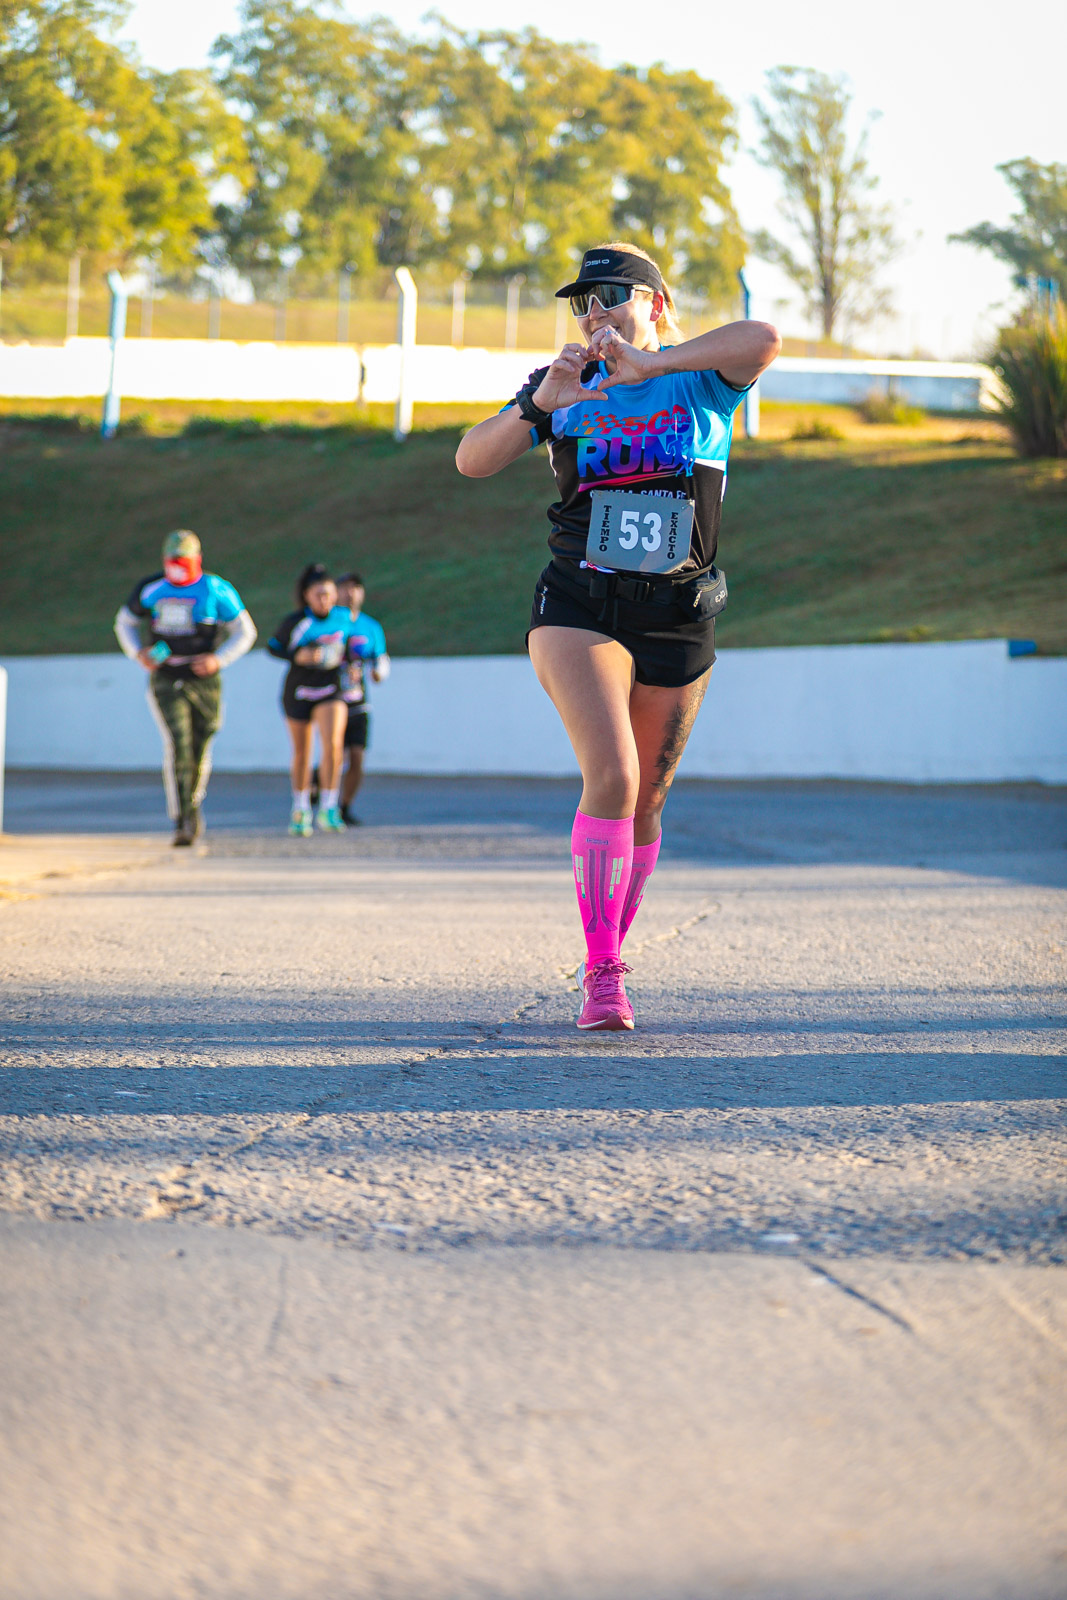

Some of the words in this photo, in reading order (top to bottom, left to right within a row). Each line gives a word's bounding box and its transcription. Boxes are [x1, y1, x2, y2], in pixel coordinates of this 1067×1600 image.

[577, 435, 685, 477] RUN
[599, 505, 612, 552] TIEMPO
[618, 510, 662, 552] 53
[667, 512, 679, 560] EXACTO
